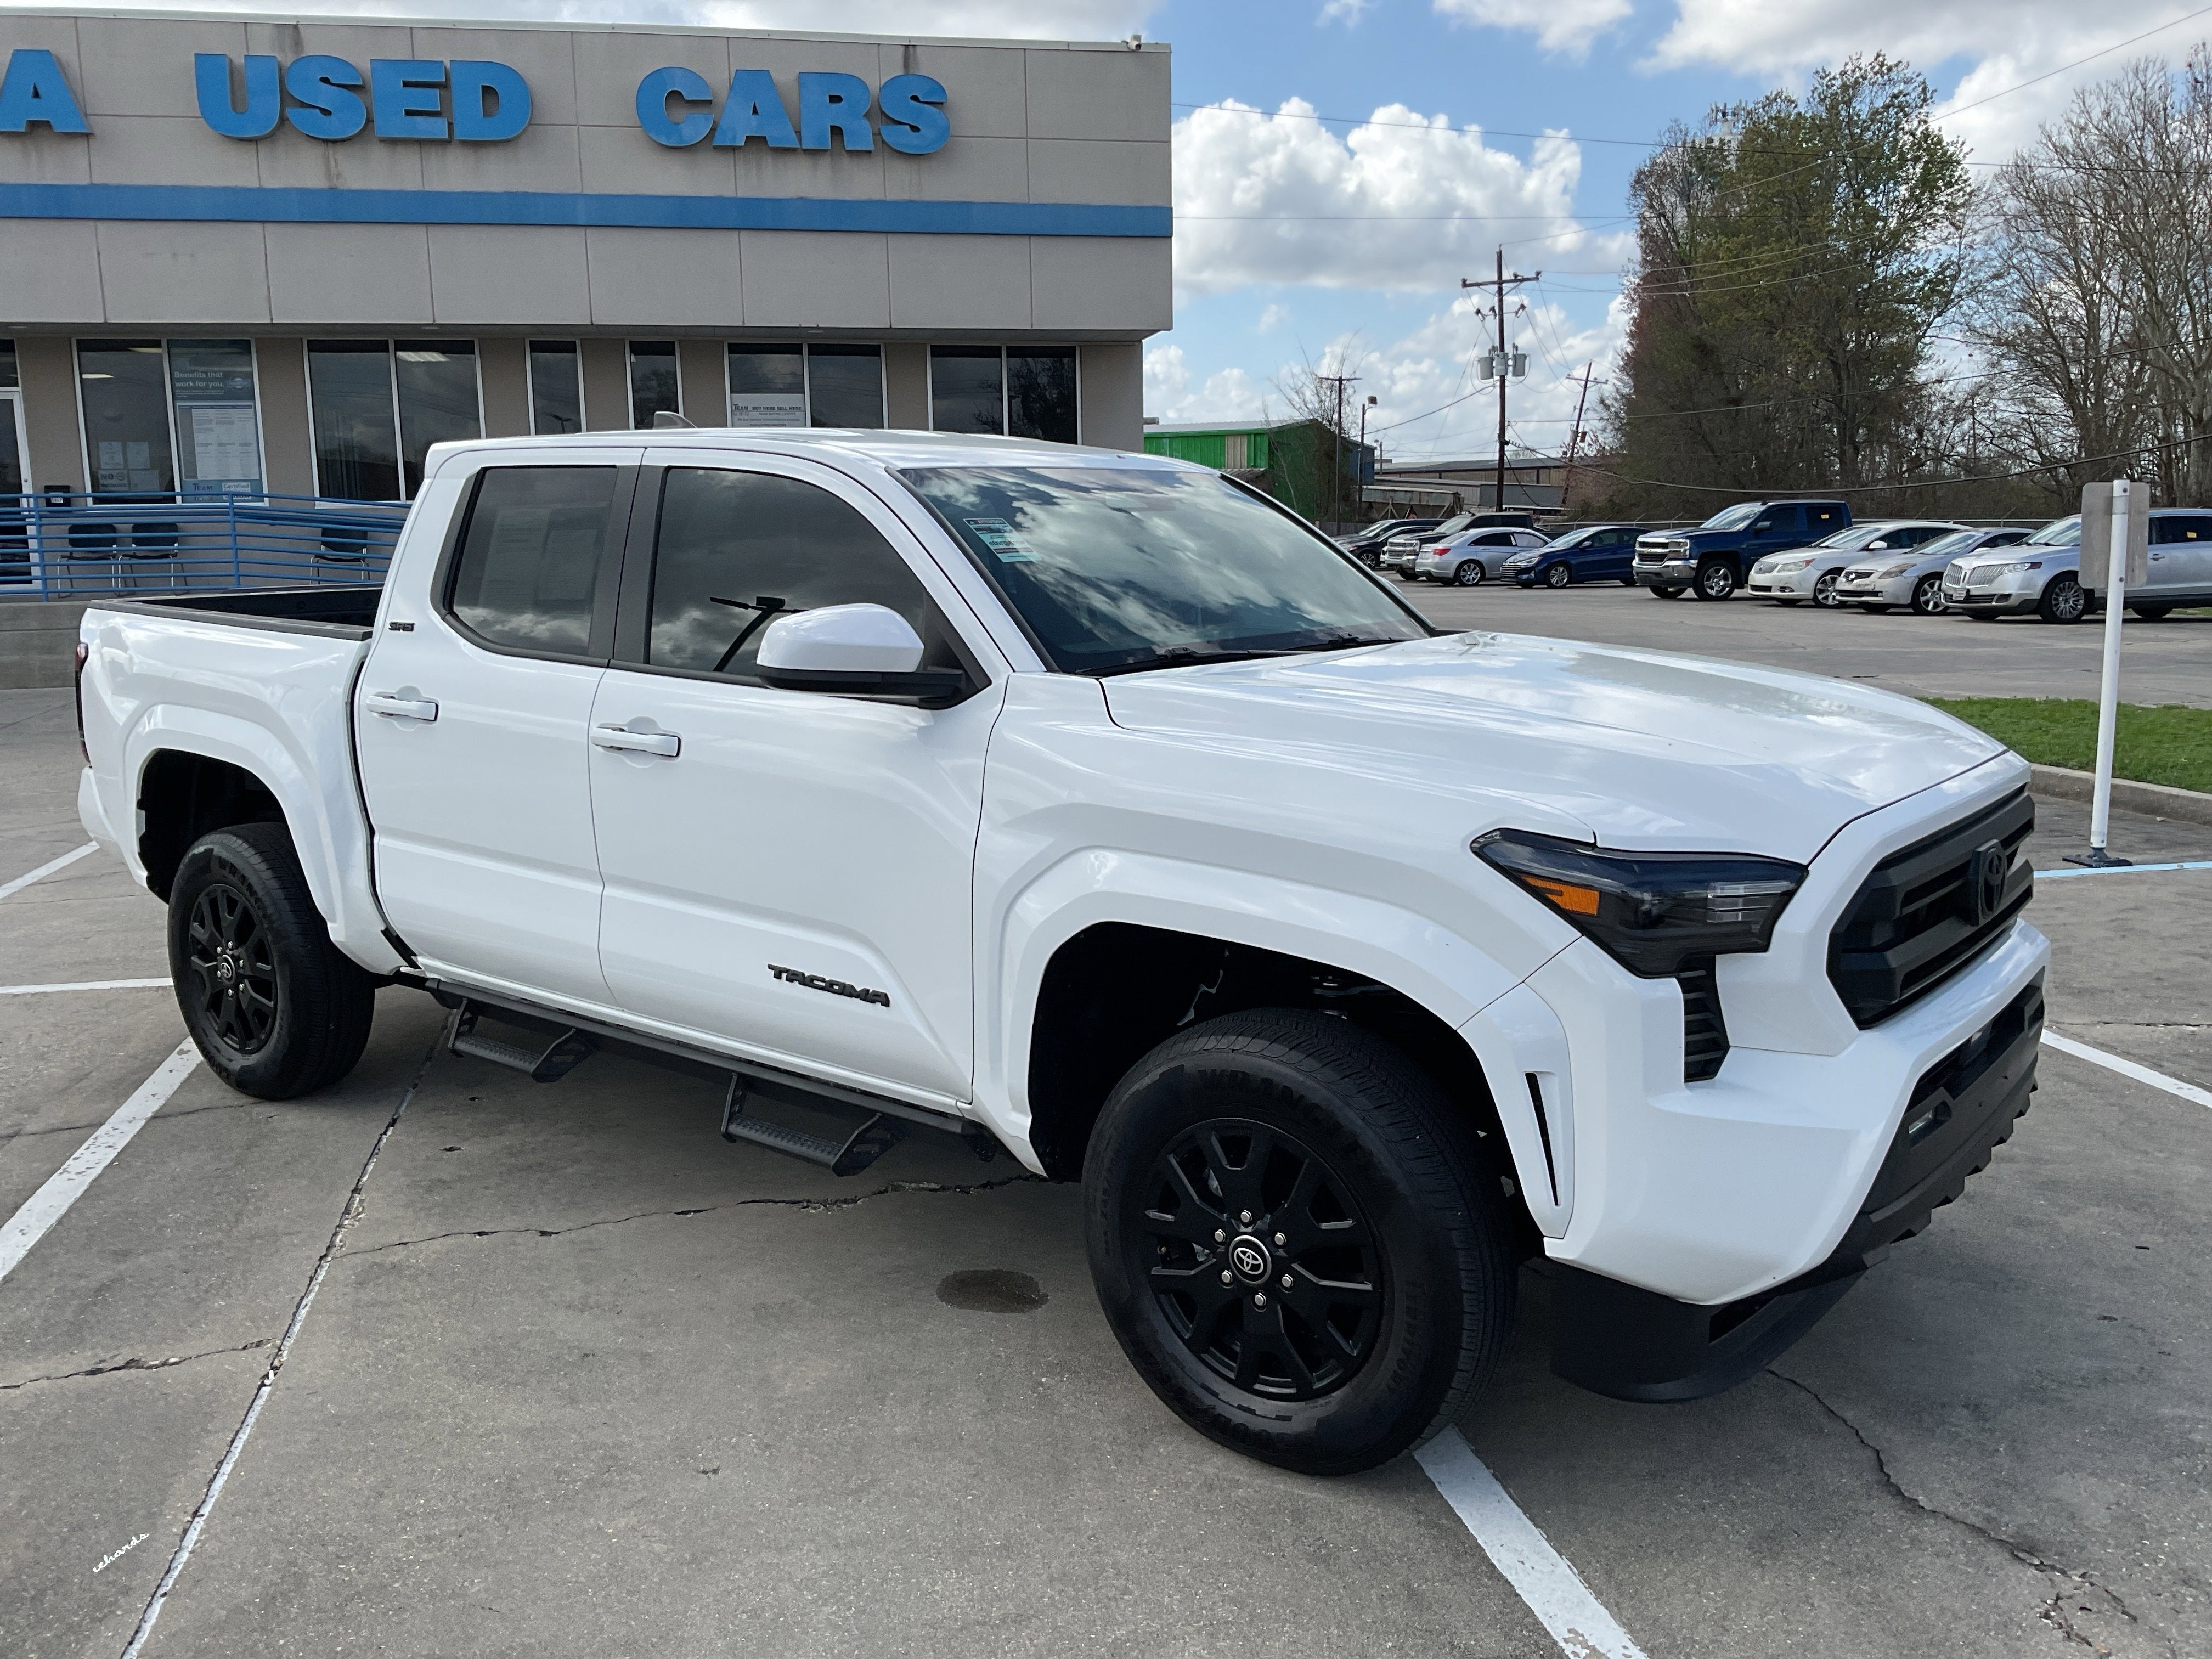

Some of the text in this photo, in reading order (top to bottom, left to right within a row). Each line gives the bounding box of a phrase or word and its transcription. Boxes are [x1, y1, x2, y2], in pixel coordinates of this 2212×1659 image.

[0, 49, 951, 155] A USED CARS
[193, 483, 213, 491] TEAM
[768, 964, 890, 1007] TACOMA
